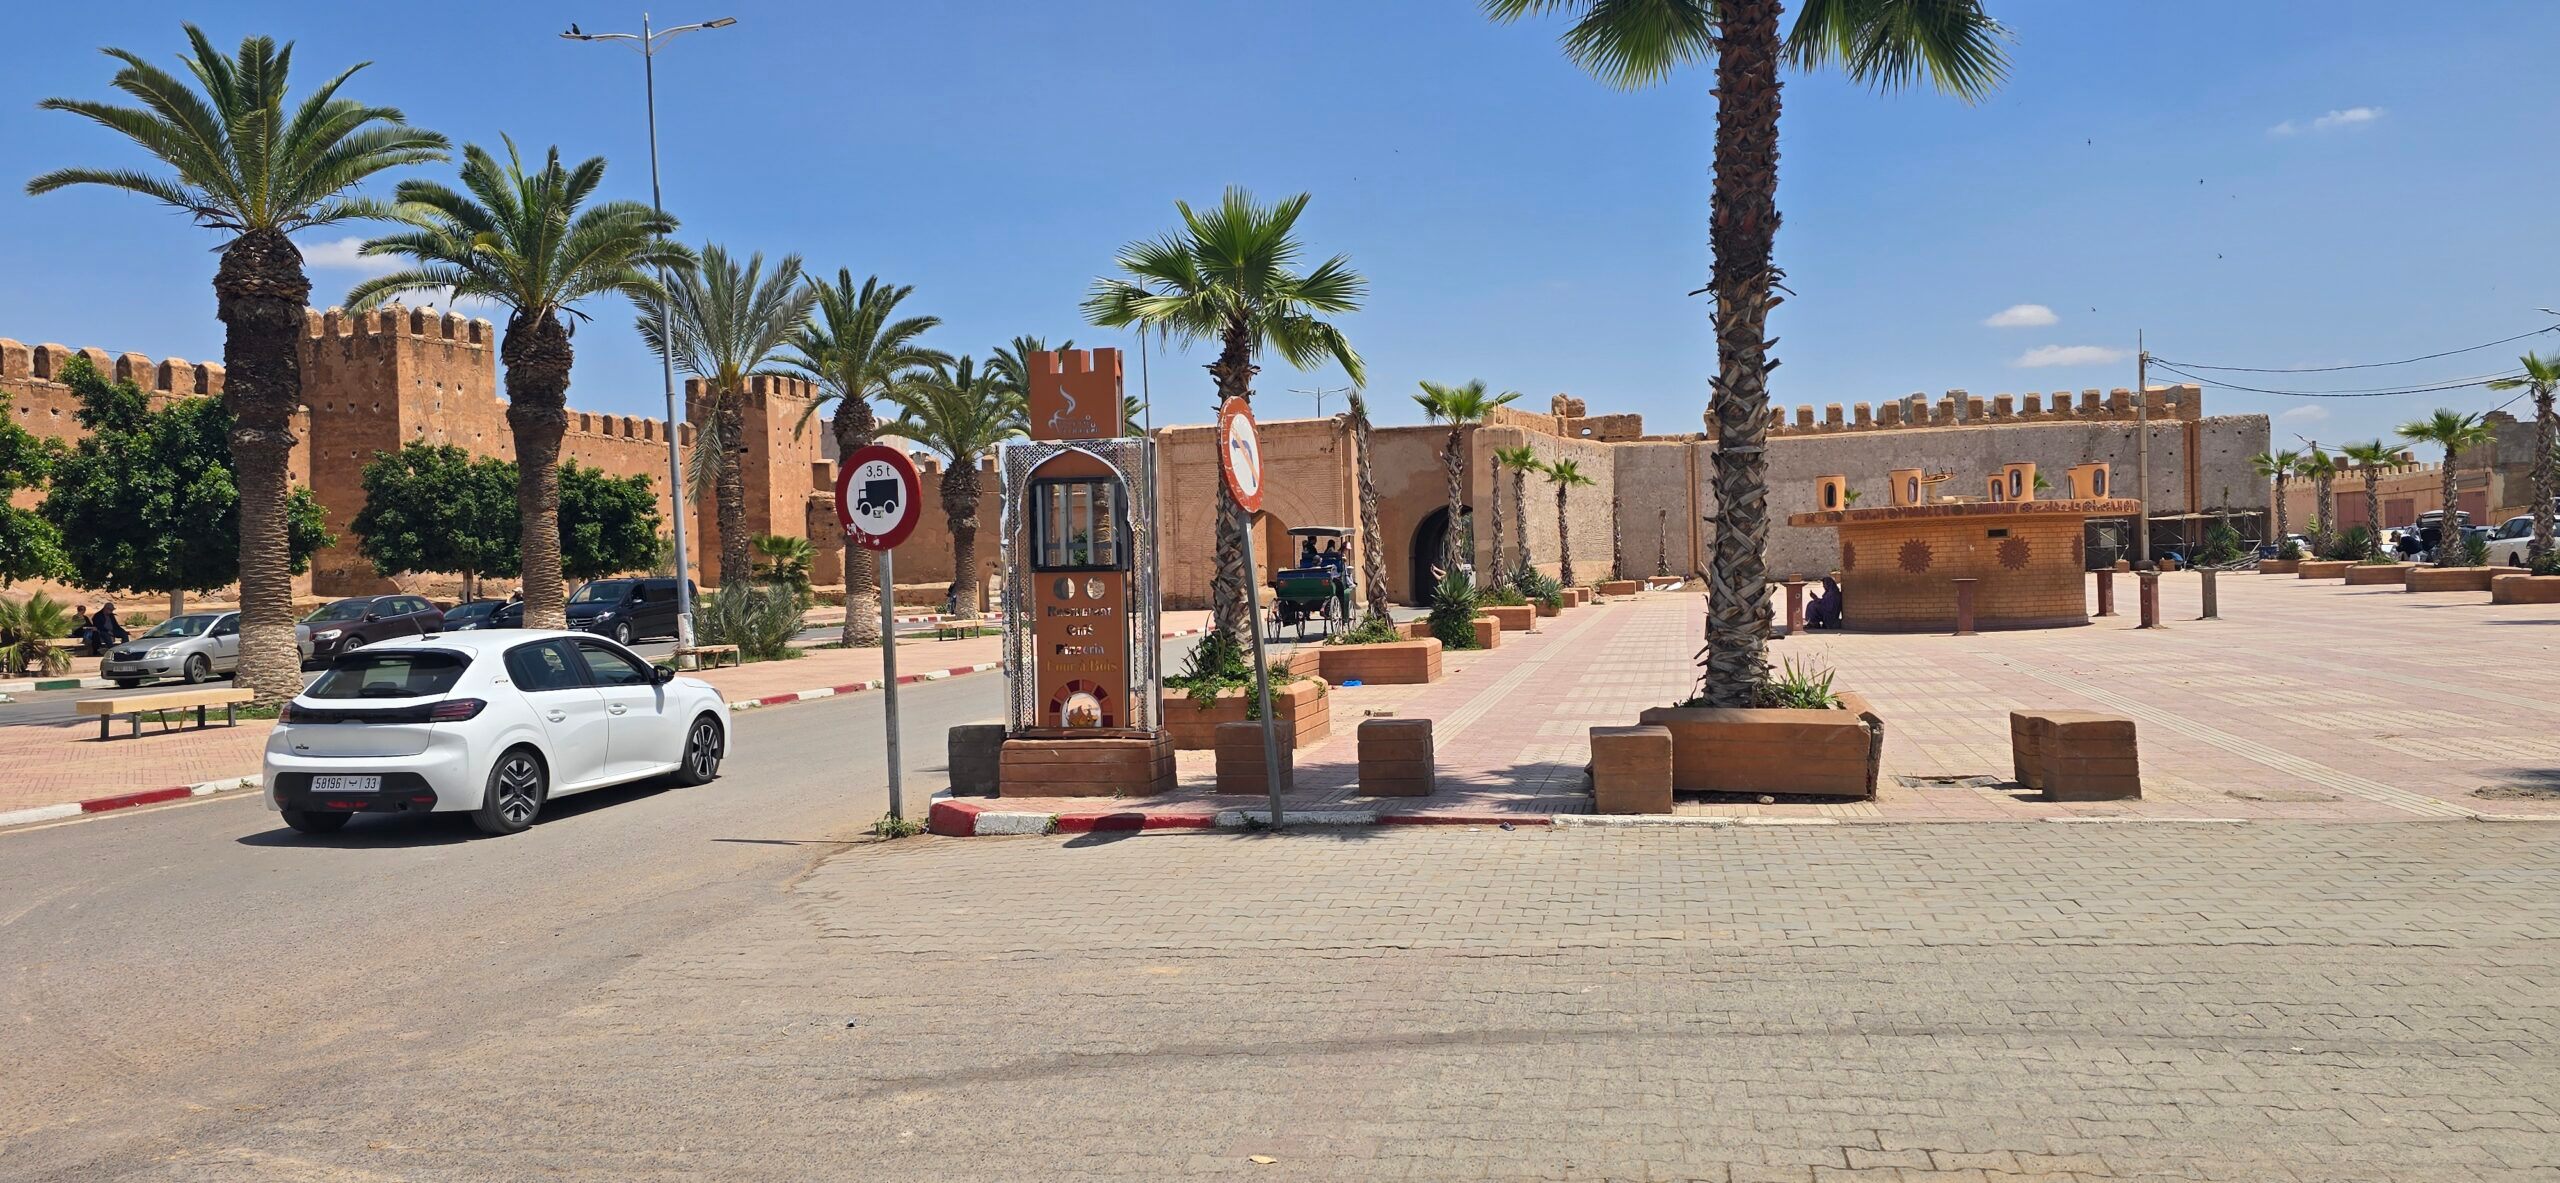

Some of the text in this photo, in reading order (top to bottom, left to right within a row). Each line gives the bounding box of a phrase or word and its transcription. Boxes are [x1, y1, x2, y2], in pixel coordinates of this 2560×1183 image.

[866, 465, 890, 478] 3,5 t
[1047, 605, 1112, 617] Restaurant
[1056, 643, 1105, 655] Pizzeria
[1089, 659, 1118, 672] Bois
[315, 777, 341, 789] 58196
[364, 778, 377, 789] 33
